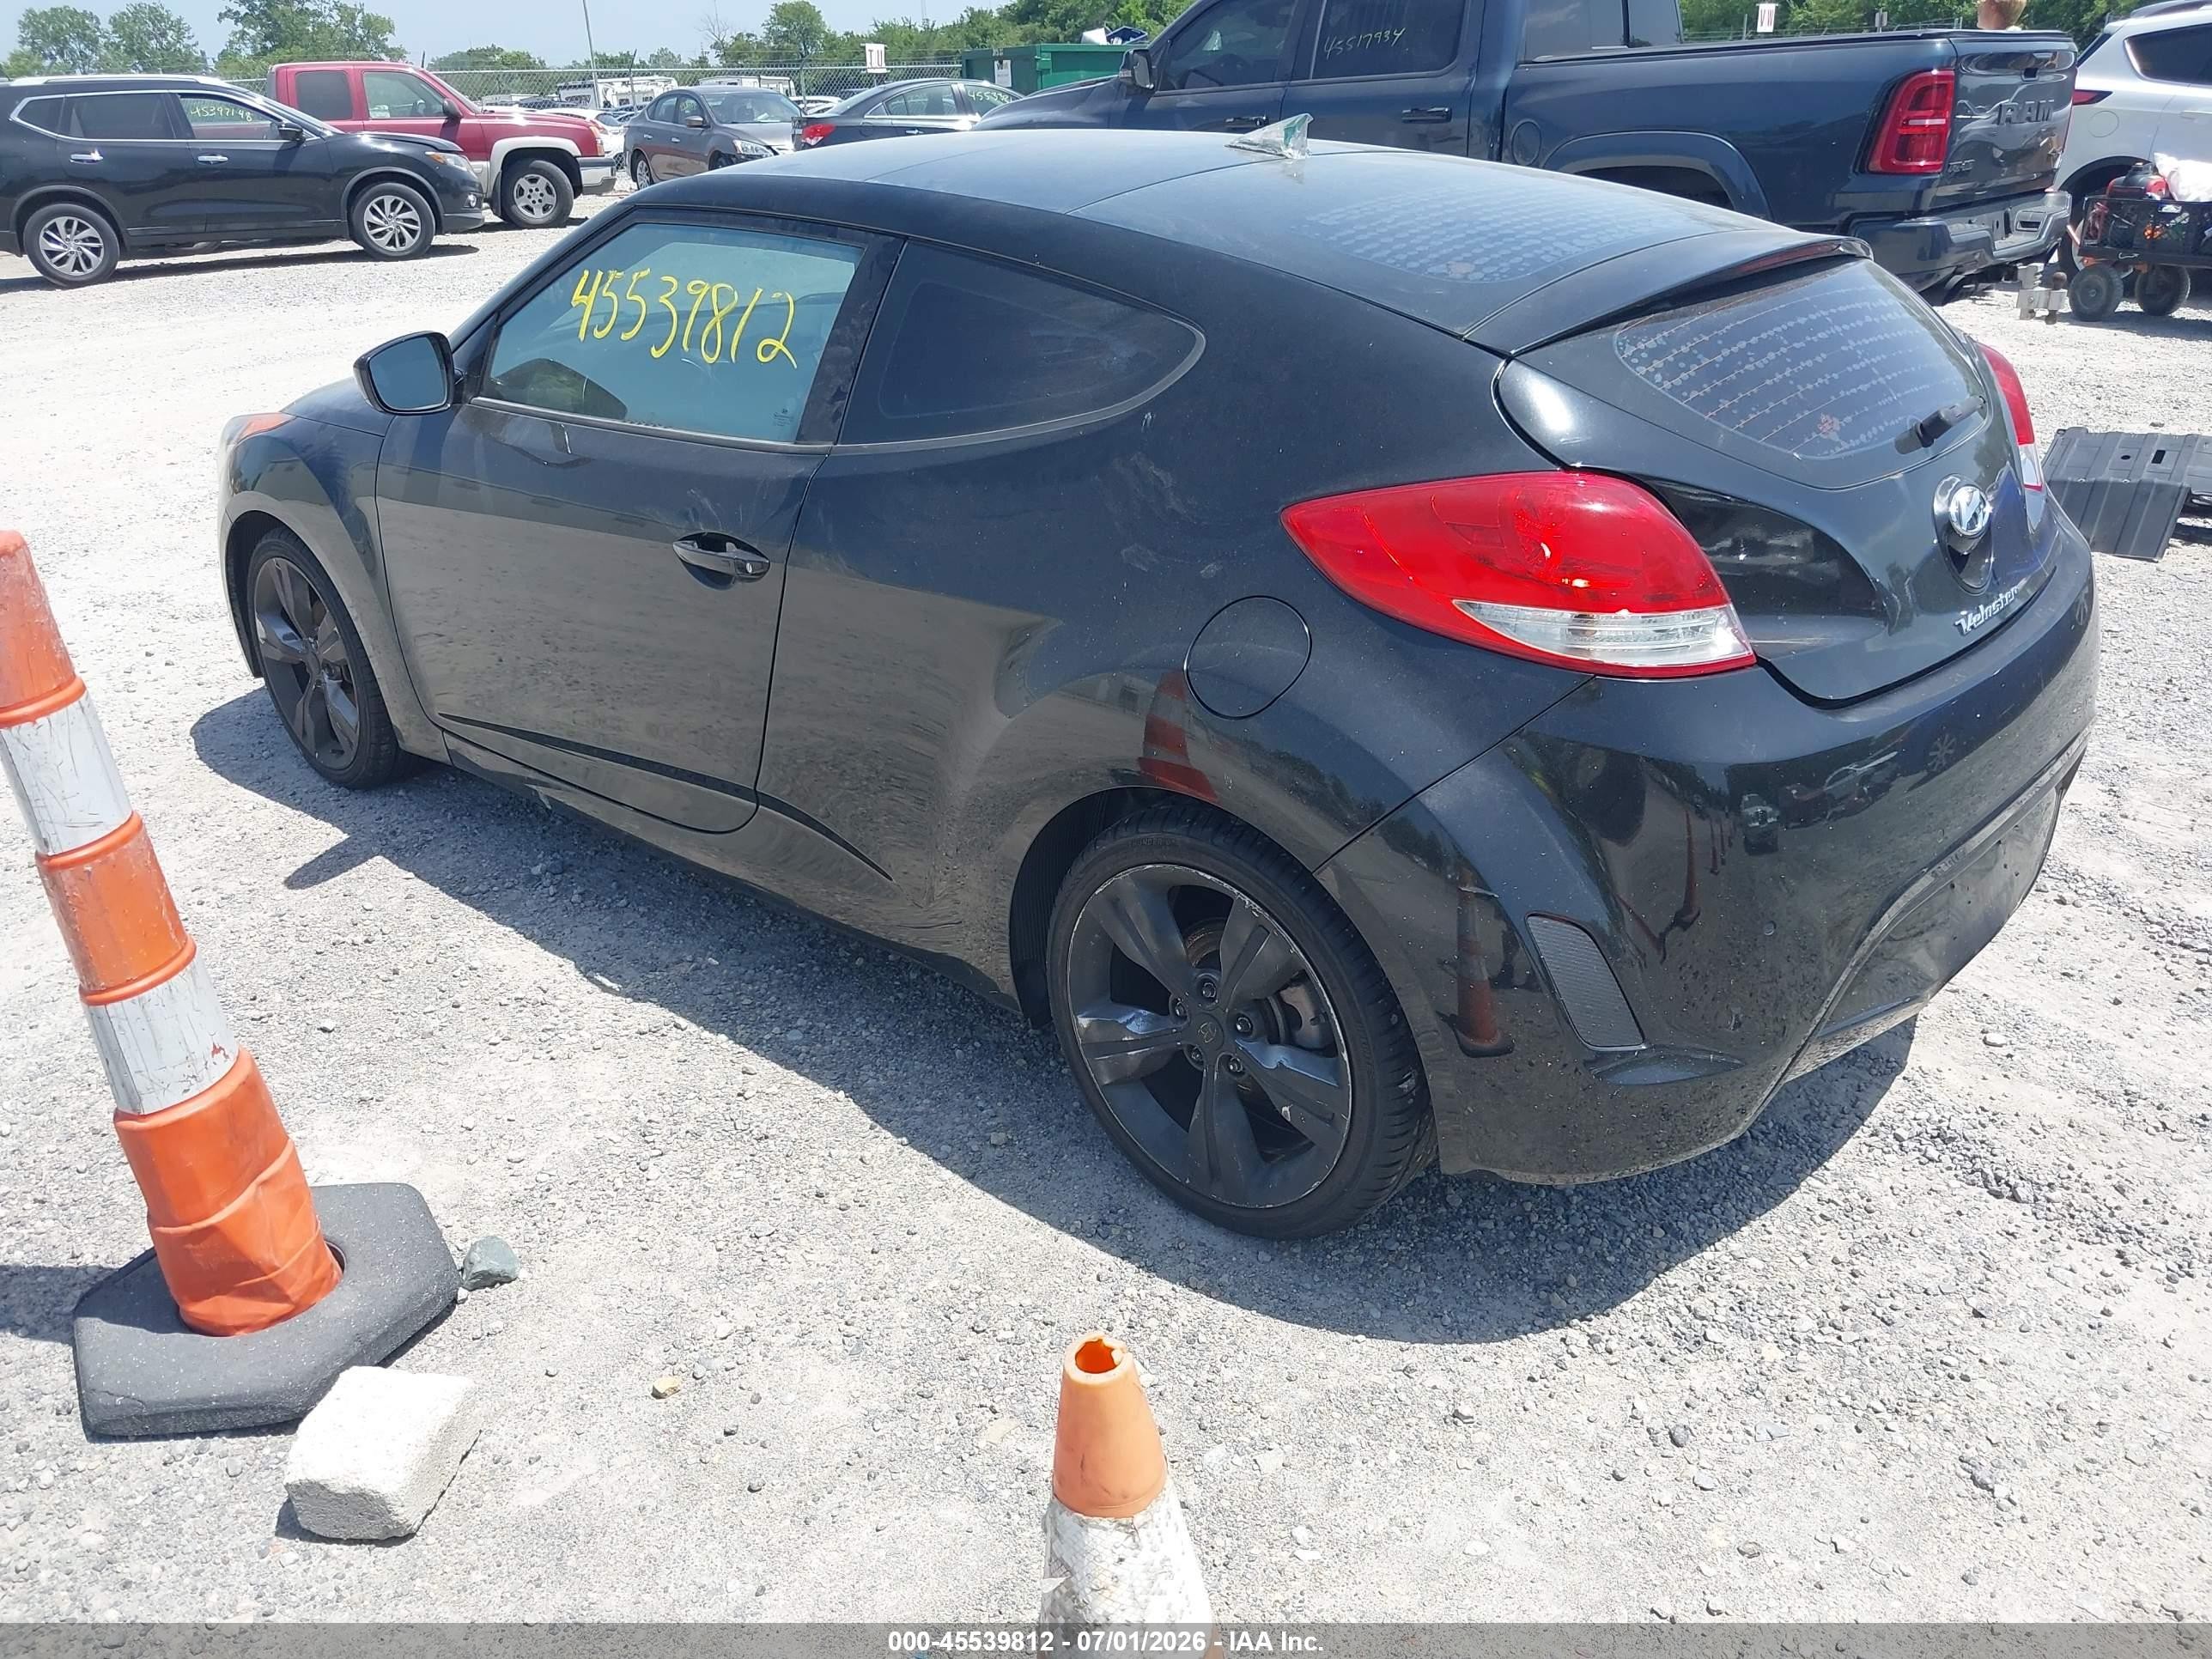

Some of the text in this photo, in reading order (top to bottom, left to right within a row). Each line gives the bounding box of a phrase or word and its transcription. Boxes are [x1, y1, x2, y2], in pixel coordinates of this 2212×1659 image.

[1324, 27, 1406, 60] 45517934
[1998, 99, 2054, 125] RAM
[570, 268, 798, 369] 45539812
[1954, 586, 2019, 635] Veloster
